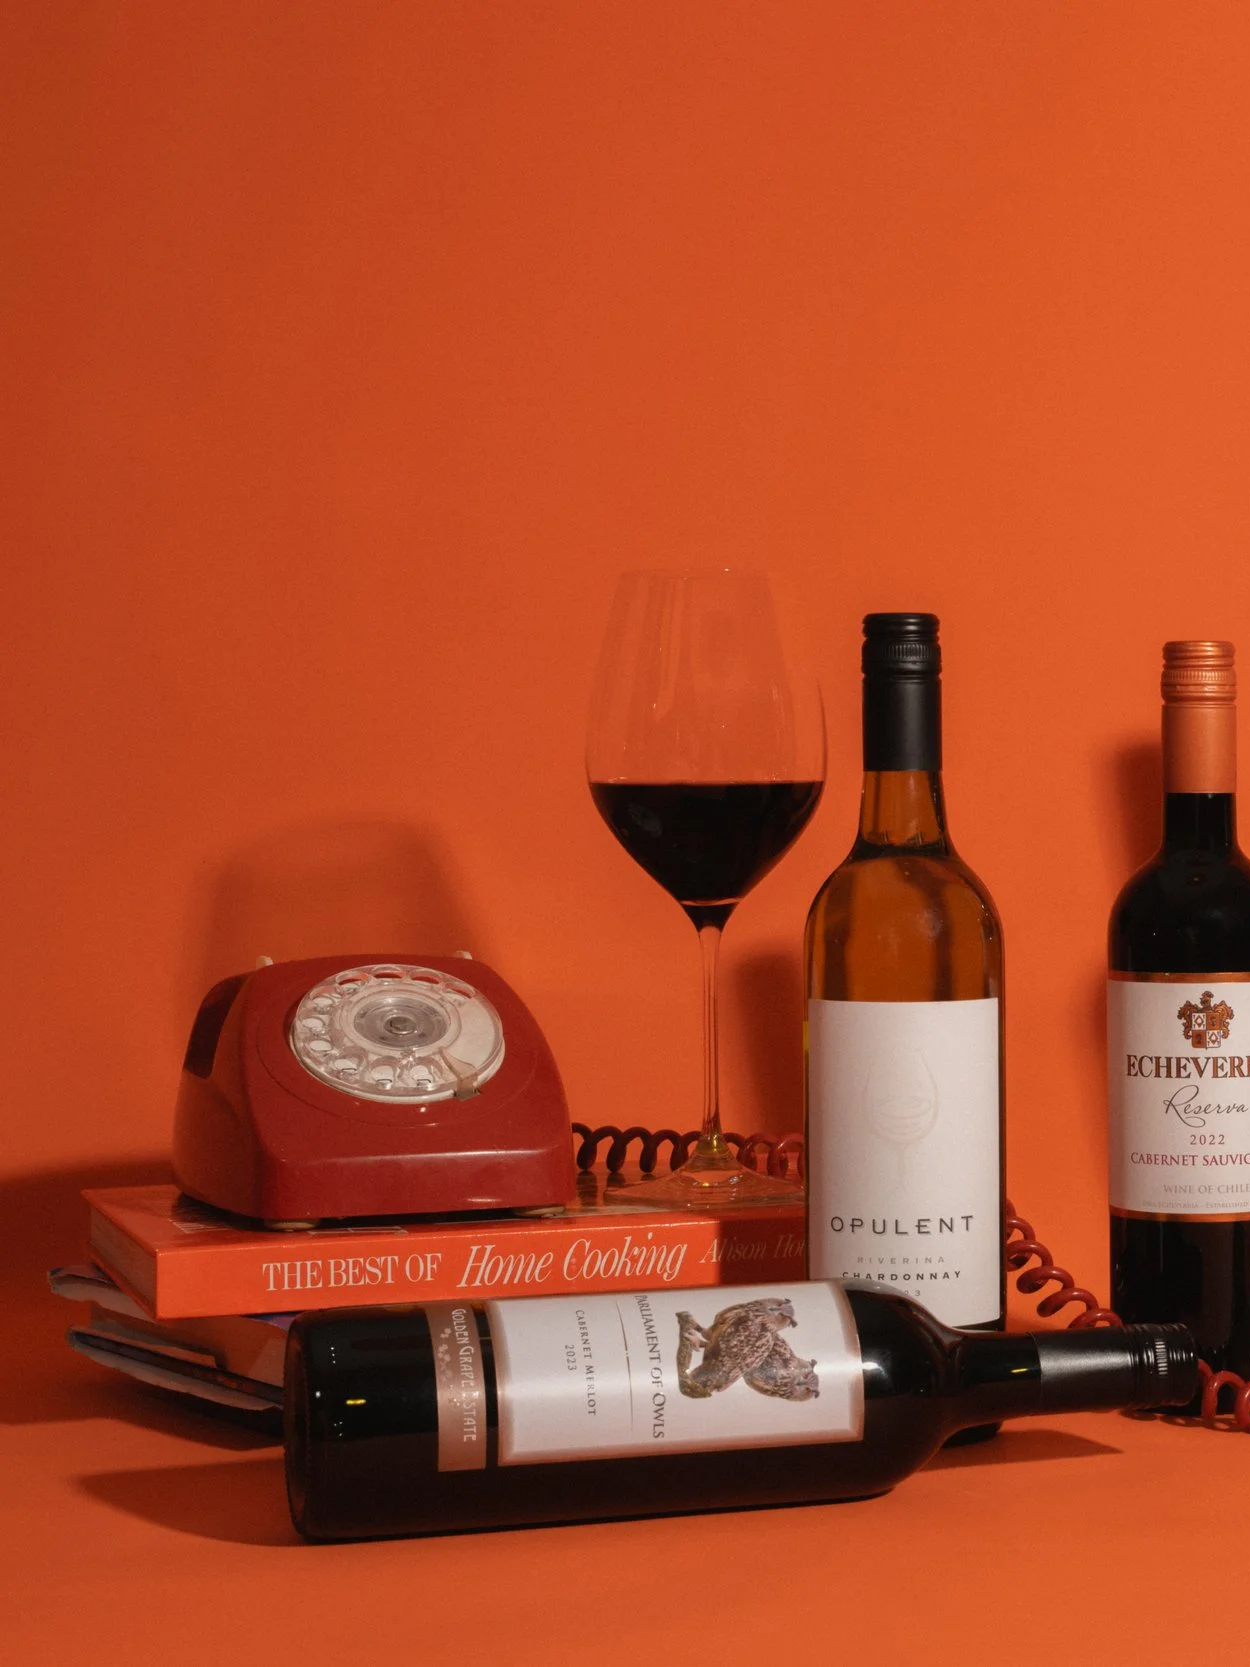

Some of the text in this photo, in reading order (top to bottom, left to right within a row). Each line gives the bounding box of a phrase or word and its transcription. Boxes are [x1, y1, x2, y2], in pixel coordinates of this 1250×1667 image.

[1163, 1084, 1249, 1129] Reserva
[1189, 1134, 1226, 1146] 2022
[1130, 1152, 1198, 1166] CABERNET
[1164, 1183, 1250, 1194] WINE OF CHILE
[830, 1215, 974, 1235] OPULENT
[263, 1260, 322, 1291] THE
[328, 1256, 399, 1287] BEST
[405, 1253, 442, 1282] OF
[456, 1245, 553, 1288] Home
[563, 1232, 688, 1281] Cooking
[700, 1236, 766, 1264] Alison
[856, 1255, 945, 1265] RIVERINA
[842, 1270, 961, 1282] CHARDONNAY
[565, 1344, 577, 1371] 2023
[575, 1310, 596, 1416] CABERNET MERLOT
[635, 1295, 666, 1439] PARLIAMENT OF OWLS
[452, 1308, 480, 1443] GOLDEN GRAPE ESTATE
